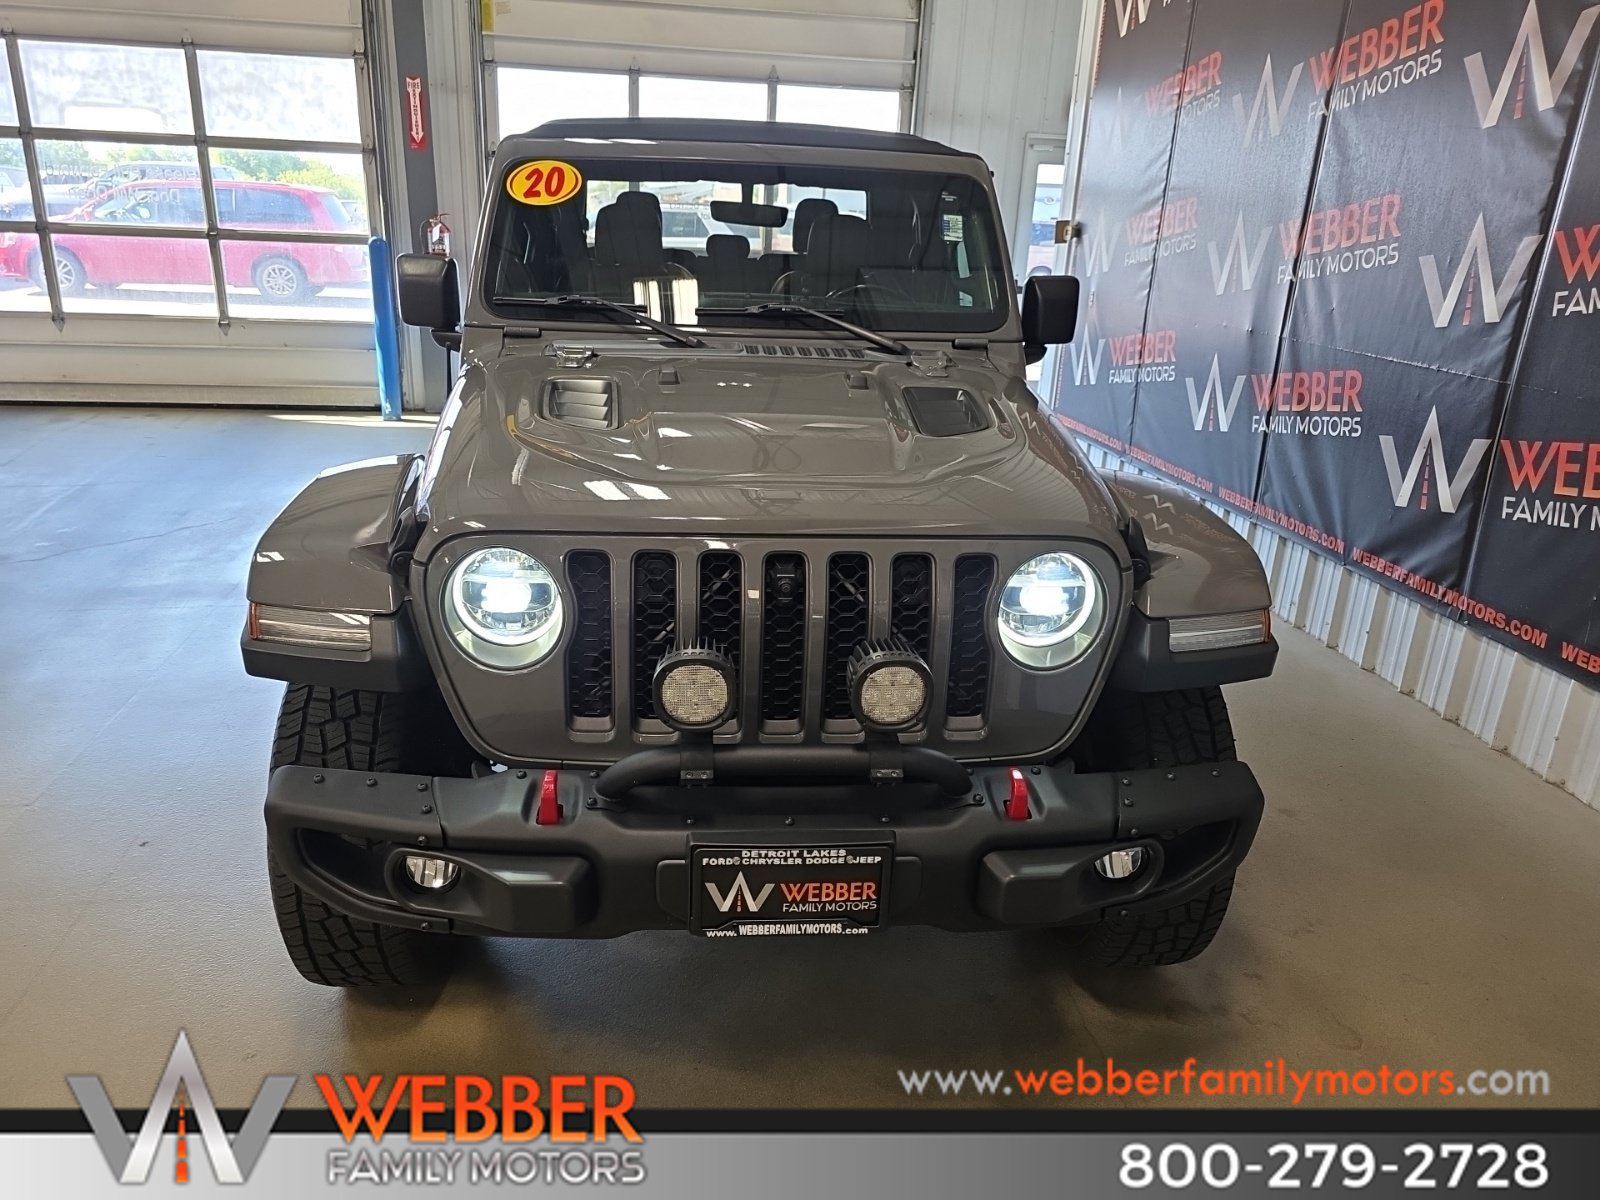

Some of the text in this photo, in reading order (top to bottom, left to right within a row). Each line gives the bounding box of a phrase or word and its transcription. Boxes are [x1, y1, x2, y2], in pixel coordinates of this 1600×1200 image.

[1309, 0, 1444, 95] WEBBER
[407, 81, 420, 90] FIRE
[1145, 50, 1222, 117] WEBBER
[1308, 48, 1442, 122] FAMILY MOTORS
[523, 166, 565, 199] 20
[1126, 196, 1198, 246] WEBBER
[1278, 193, 1403, 260] WEBBER
[1157, 233, 1197, 259] MOTORS
[1277, 242, 1399, 284] FAMILY MOTORS
[1109, 330, 1177, 367] WEBBER
[1109, 366, 1175, 384] FAMILY MOTORS
[1251, 369, 1363, 412] WEBBER
[1252, 415, 1362, 438] FAMILY MOTORS
[1125, 443, 1214, 493] WEBBERFAMILYMOTORS.COM
[1218, 485, 1344, 554] WEBBERFAMILYMOTORS.COM
[1501, 496, 1587, 530] FAMILY
[1352, 547, 1548, 649] WEBBERFAMILYMOTORS.COM
[702, 856, 881, 866] FORD CHRYSLER DODGE JEEP
[742, 849, 847, 858] DETROIT LAKES
[780, 882, 878, 902] WEBBER
[782, 900, 877, 913] FAMILY MOTORS
